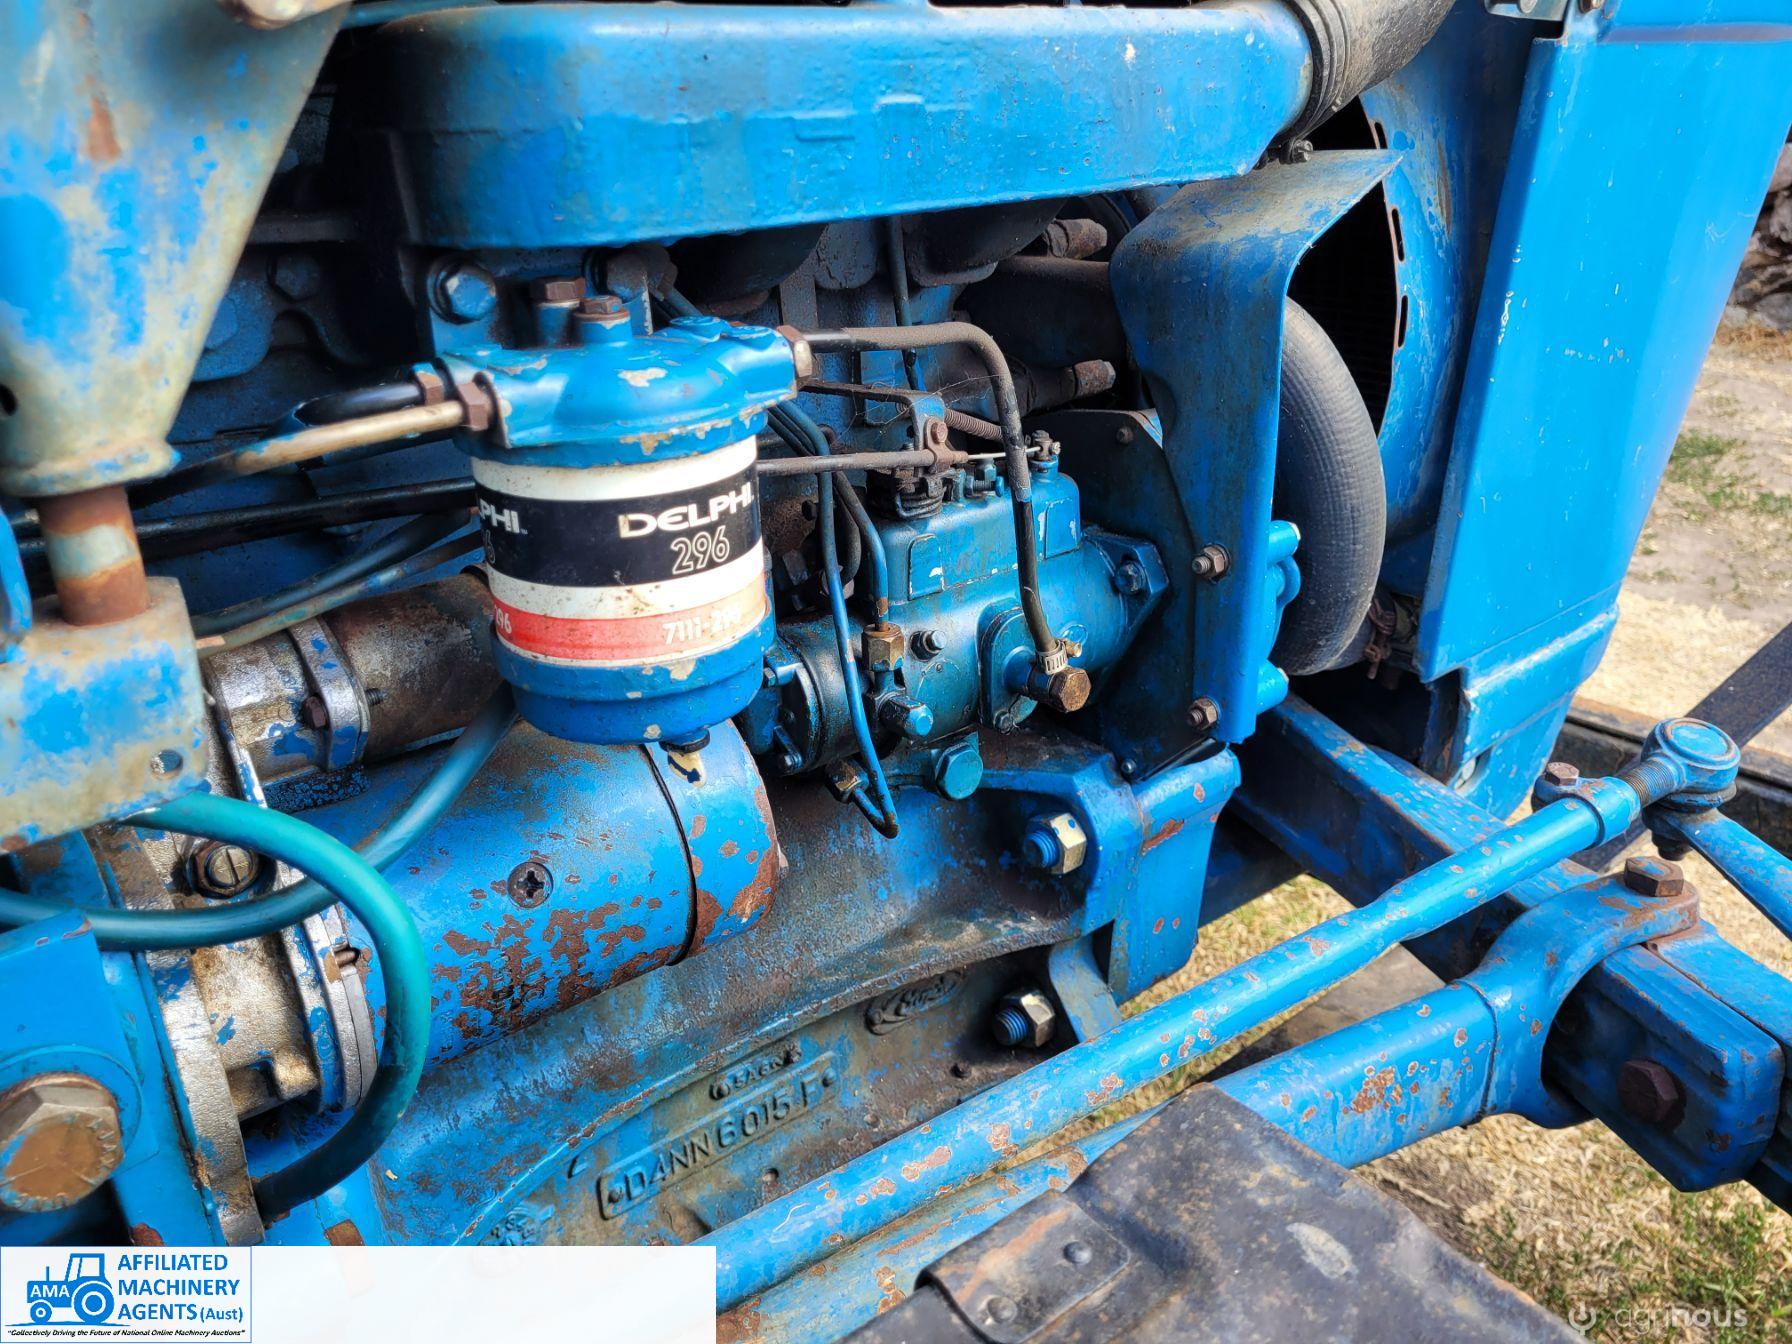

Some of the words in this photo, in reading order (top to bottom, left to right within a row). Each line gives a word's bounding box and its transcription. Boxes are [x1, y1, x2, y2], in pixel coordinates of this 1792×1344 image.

[479, 498, 520, 533] PHI
[618, 481, 752, 538] DELPHI
[670, 525, 730, 575] 296
[494, 604, 512, 634] 96
